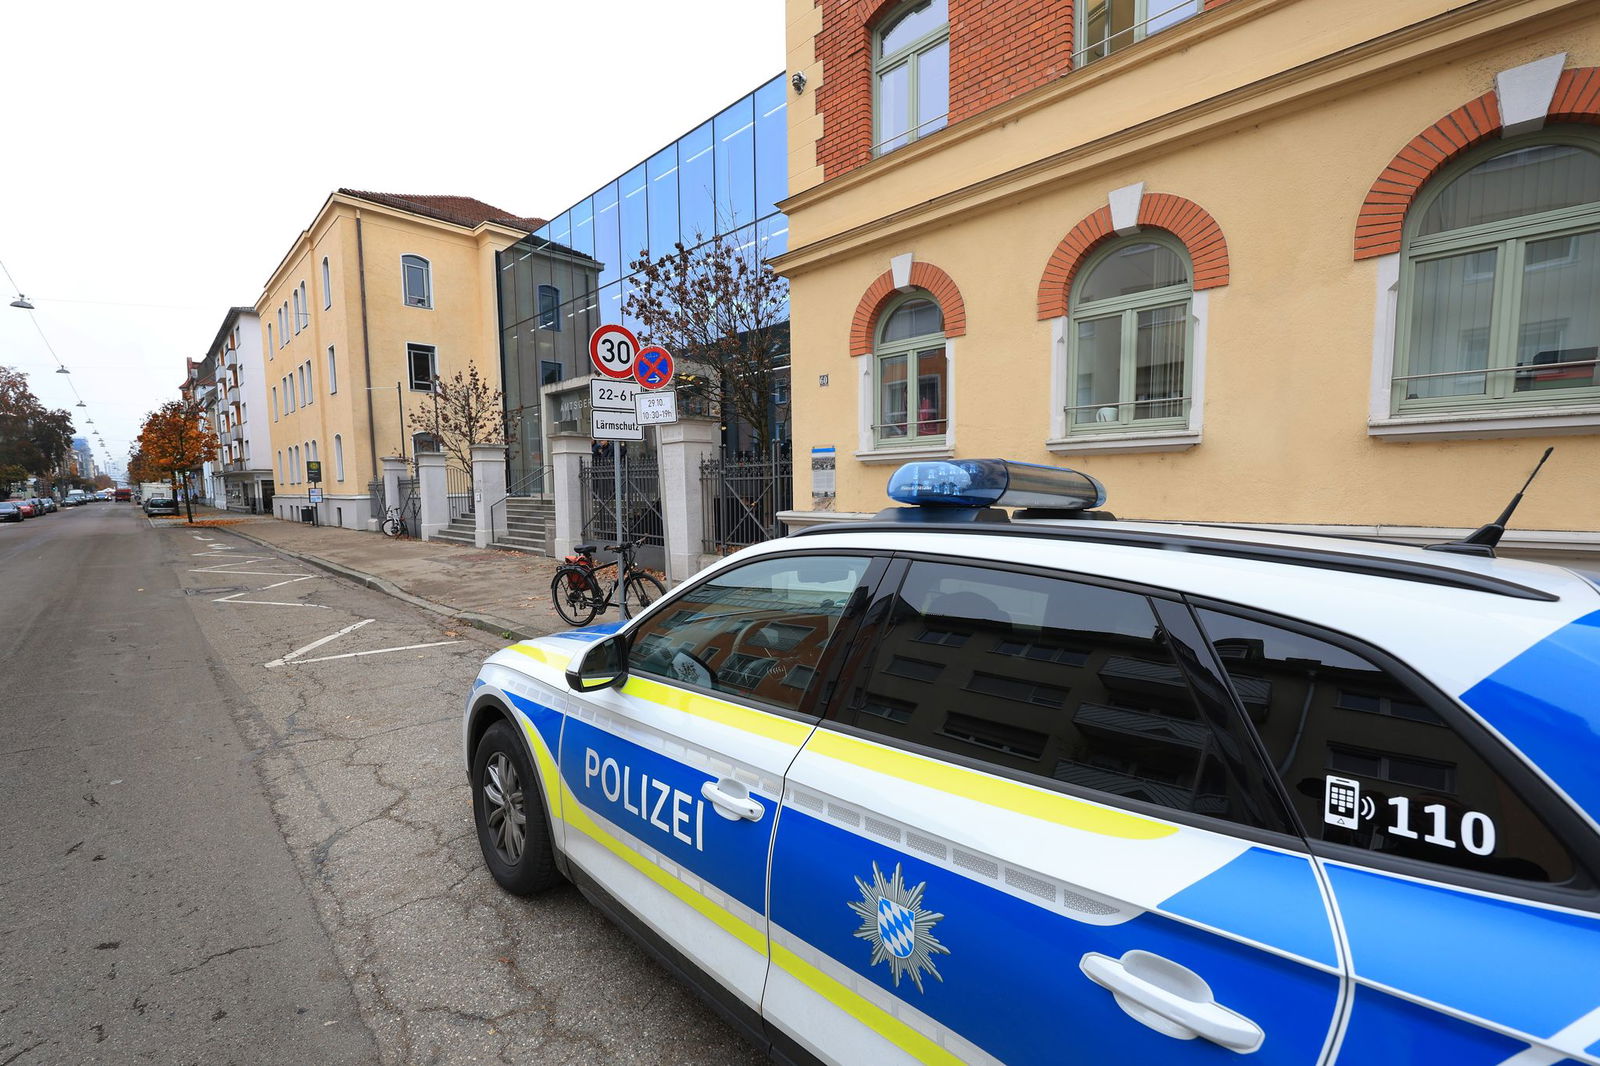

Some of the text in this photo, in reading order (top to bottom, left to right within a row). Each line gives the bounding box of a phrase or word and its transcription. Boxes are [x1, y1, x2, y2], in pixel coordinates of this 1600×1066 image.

[601, 338, 631, 364] 30
[598, 388, 627, 401] 22-6
[595, 419, 640, 431] Lärmschutz
[585, 747, 704, 852] POLIZEI
[1387, 796, 1496, 856] 110
